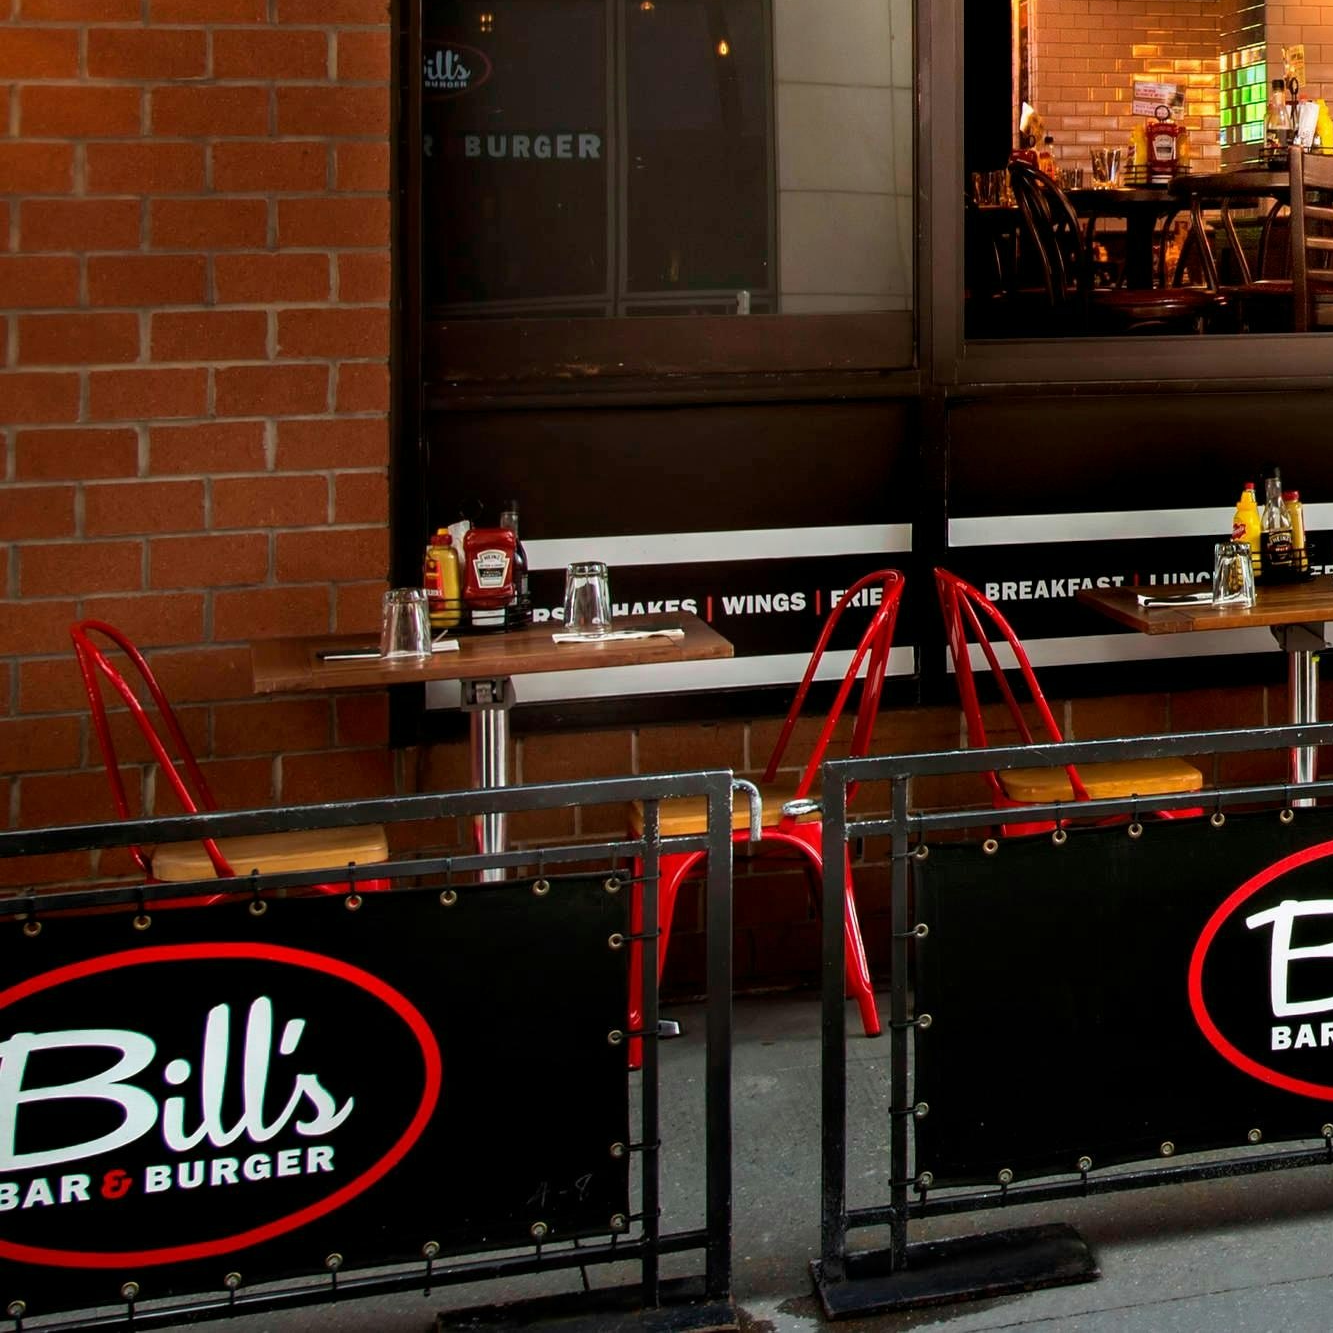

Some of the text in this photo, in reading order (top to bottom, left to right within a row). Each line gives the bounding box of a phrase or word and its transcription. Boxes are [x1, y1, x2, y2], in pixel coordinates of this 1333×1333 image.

[424, 49, 471, 80] ill's
[464, 133, 601, 159] BURGER
[612, 598, 698, 617] HAKES
[721, 592, 807, 616] WINGS
[830, 587, 884, 609] FRIE
[0, 995, 355, 1171] Bill's
[101, 1168, 134, 1199] &
[143, 1145, 336, 1195] BURGER
